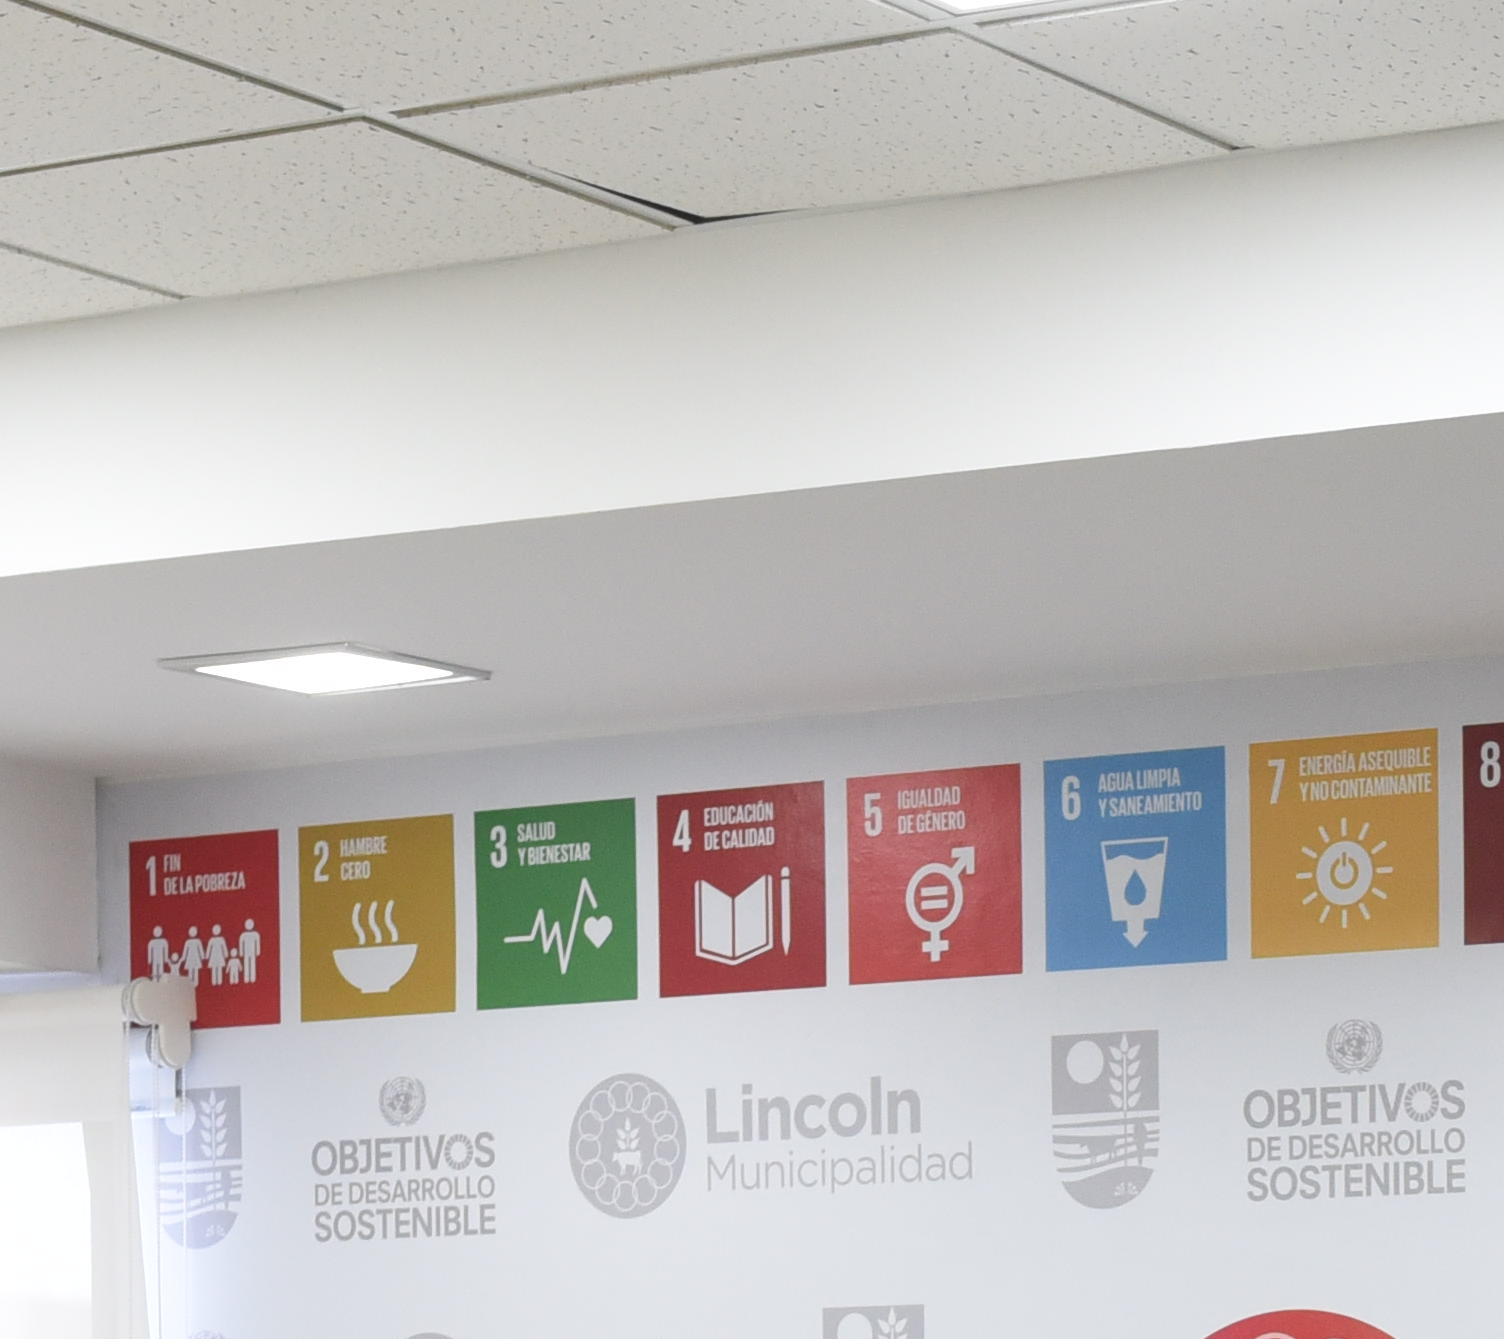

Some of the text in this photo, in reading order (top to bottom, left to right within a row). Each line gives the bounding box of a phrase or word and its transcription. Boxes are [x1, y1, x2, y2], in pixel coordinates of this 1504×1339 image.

[1300, 747, 1430, 776] ENERGÍA ASEQUIBLE
[1480, 741, 1500, 787] 8
[1099, 768, 1180, 792] AGUA LIMPIA
[1269, 759, 1284, 804] 7
[1300, 773, 1432, 801] Y NO CONTAMINANTE
[704, 800, 773, 826] EDUCACIÓN
[898, 786, 960, 809] IGUALDAD
[1062, 776, 1081, 820] 6
[1099, 792, 1201, 817] Y SANEAMIENTO
[864, 793, 882, 836] 5
[898, 810, 965, 834] DE GÉNERO
[340, 836, 387, 856] HAMBRE
[491, 826, 507, 868] 3
[517, 822, 555, 842] SALUD
[673, 810, 691, 852] 4
[704, 827, 774, 850] DE CALIDAD
[164, 855, 180, 872] FIN
[314, 841, 329, 882] 2
[518, 842, 590, 865] Y BIENESTAR
[146, 856, 156, 896] 1
[164, 872, 245, 895] DE LA POBREZA
[341, 861, 371, 880] CERO
[706, 1076, 921, 1144] Lincoln
[1244, 1080, 1465, 1128] OBJETIVOS
[311, 1132, 495, 1176] OBJETIVOS
[1247, 1128, 1465, 1162] DE DESARROLLO
[707, 1140, 973, 1194] Municipalidad
[1248, 1159, 1465, 1201] SOSTENIBLE
[315, 1175, 495, 1206] DE DESARROLLO
[315, 1204, 496, 1242] SOSTENIBLE
